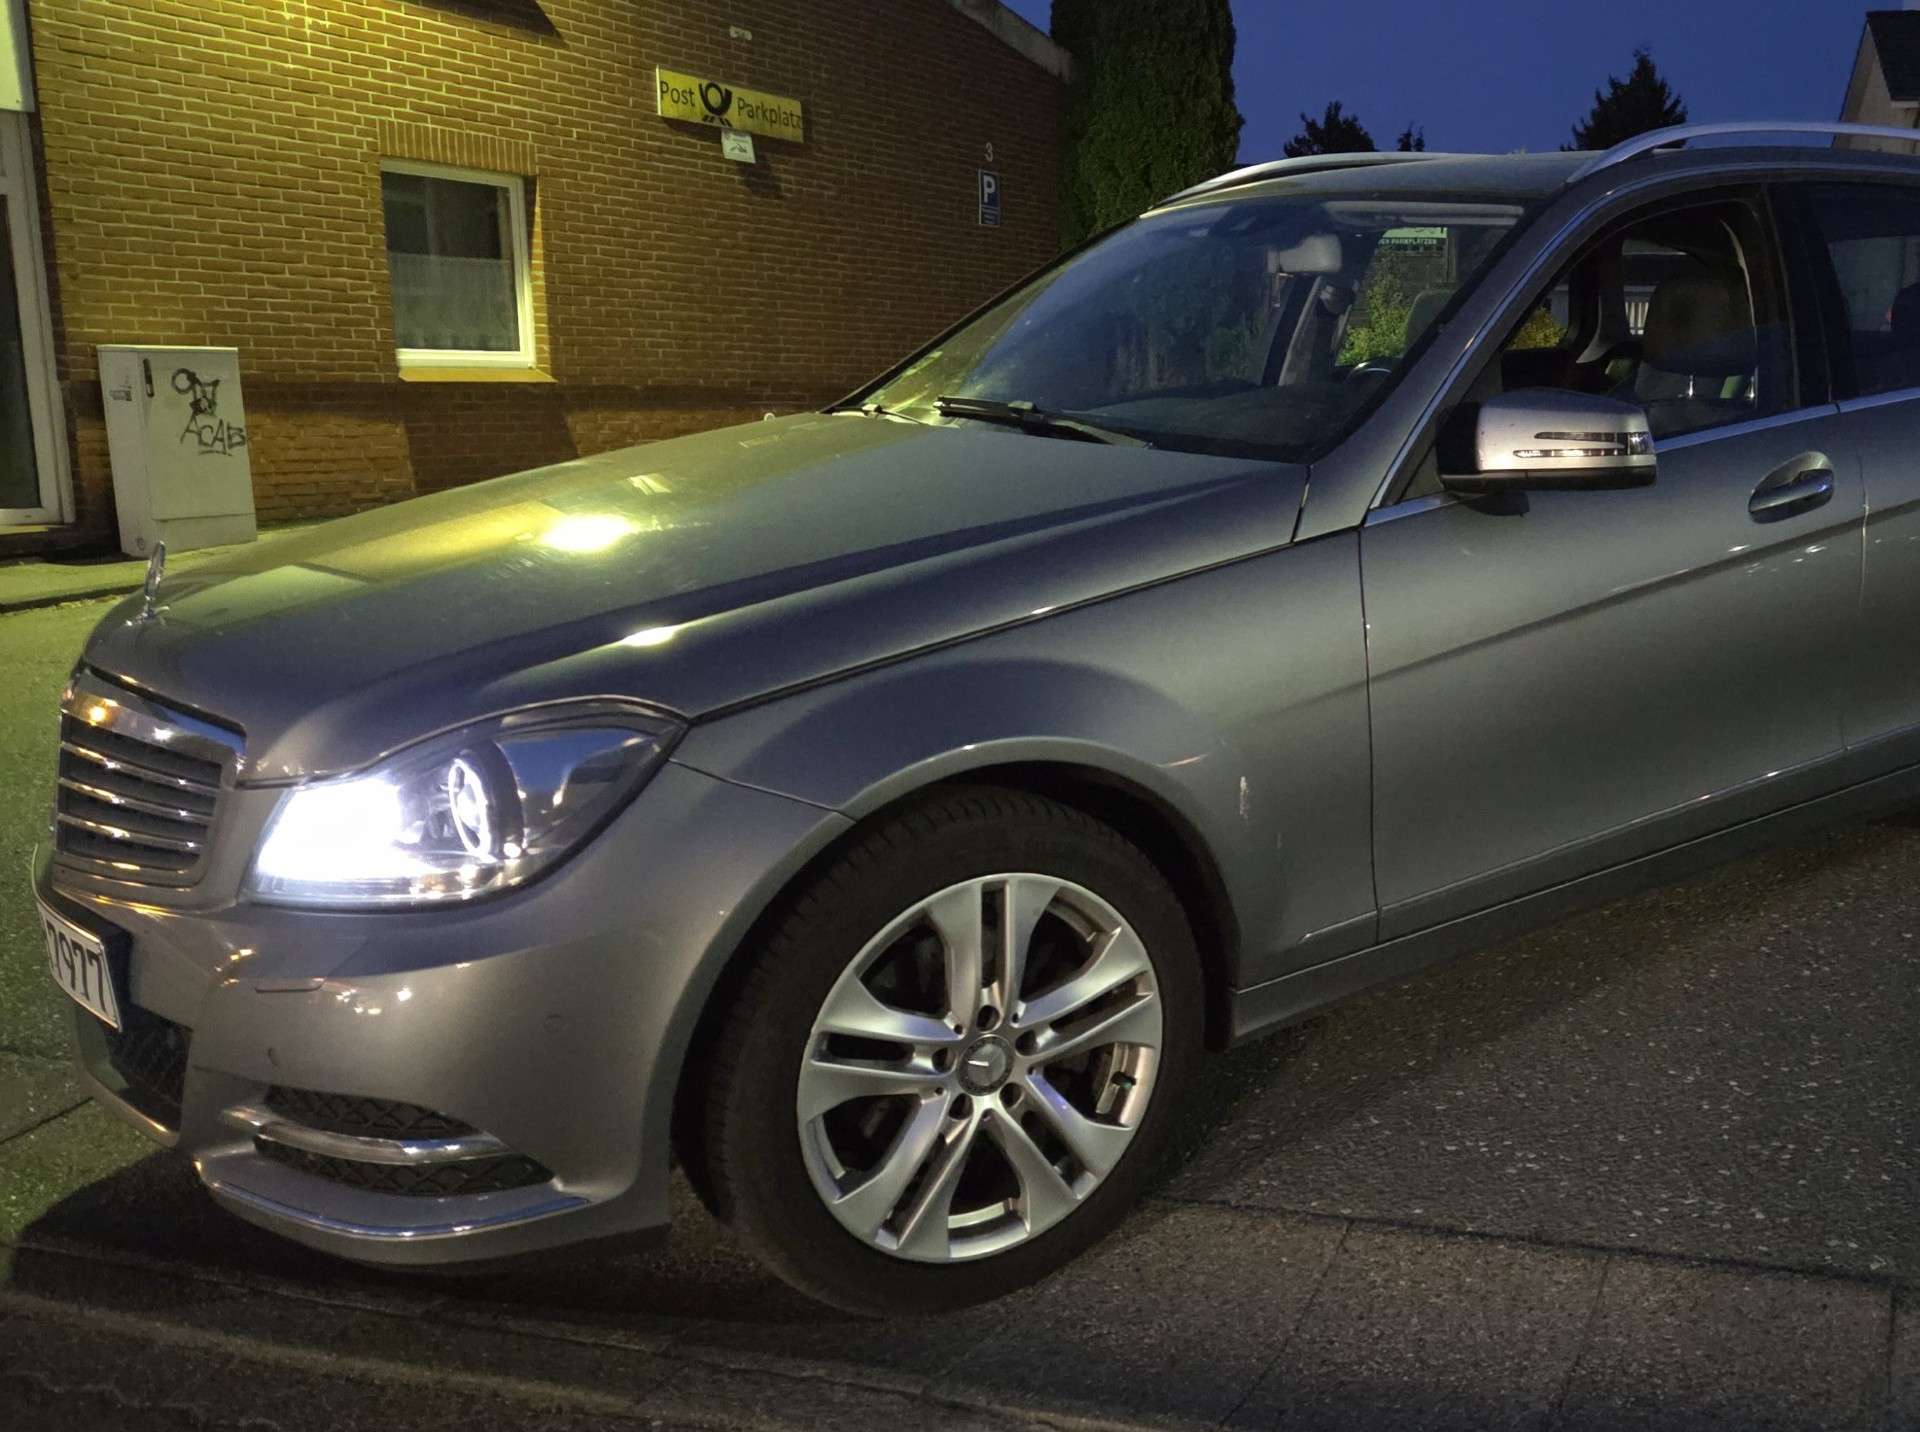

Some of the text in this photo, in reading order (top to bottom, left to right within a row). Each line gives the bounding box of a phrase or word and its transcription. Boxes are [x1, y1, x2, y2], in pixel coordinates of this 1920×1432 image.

[660, 80, 804, 129] Post Parkplatz
[984, 142, 994, 163] 3
[983, 175, 996, 203] P
[180, 413, 246, 455] ACAB
